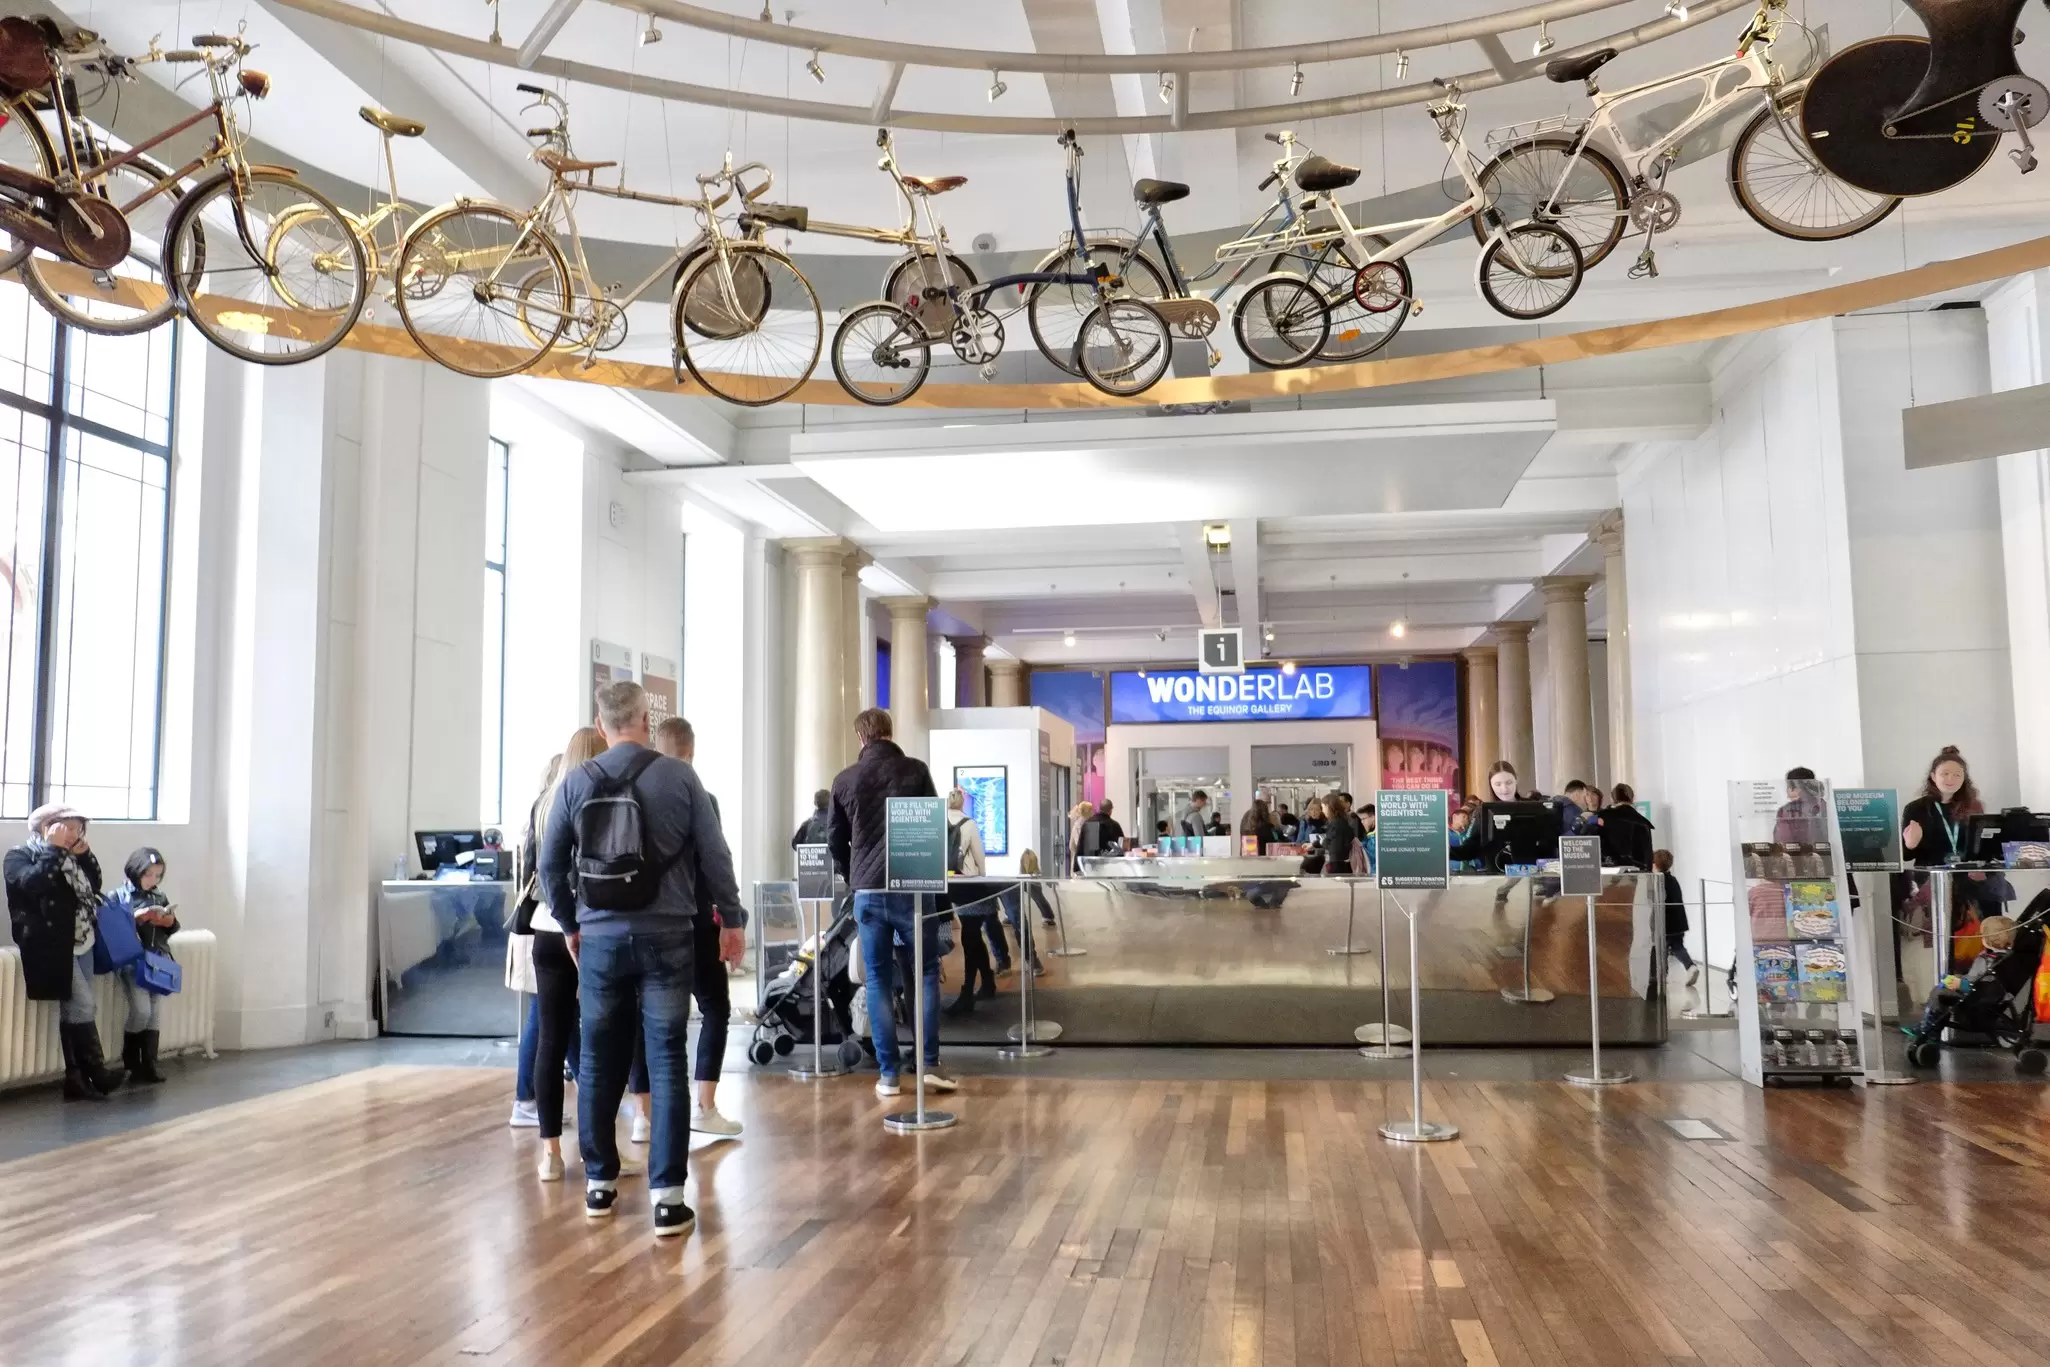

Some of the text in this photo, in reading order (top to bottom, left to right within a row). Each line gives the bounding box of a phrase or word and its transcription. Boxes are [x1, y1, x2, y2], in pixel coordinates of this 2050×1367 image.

[1147, 672, 1334, 703] WONDERLAB
[644, 691, 668, 711] SPACE
[1187, 703, 1293, 716] THE EQUINOR GALLERY
[1381, 876, 1393, 885] £5
